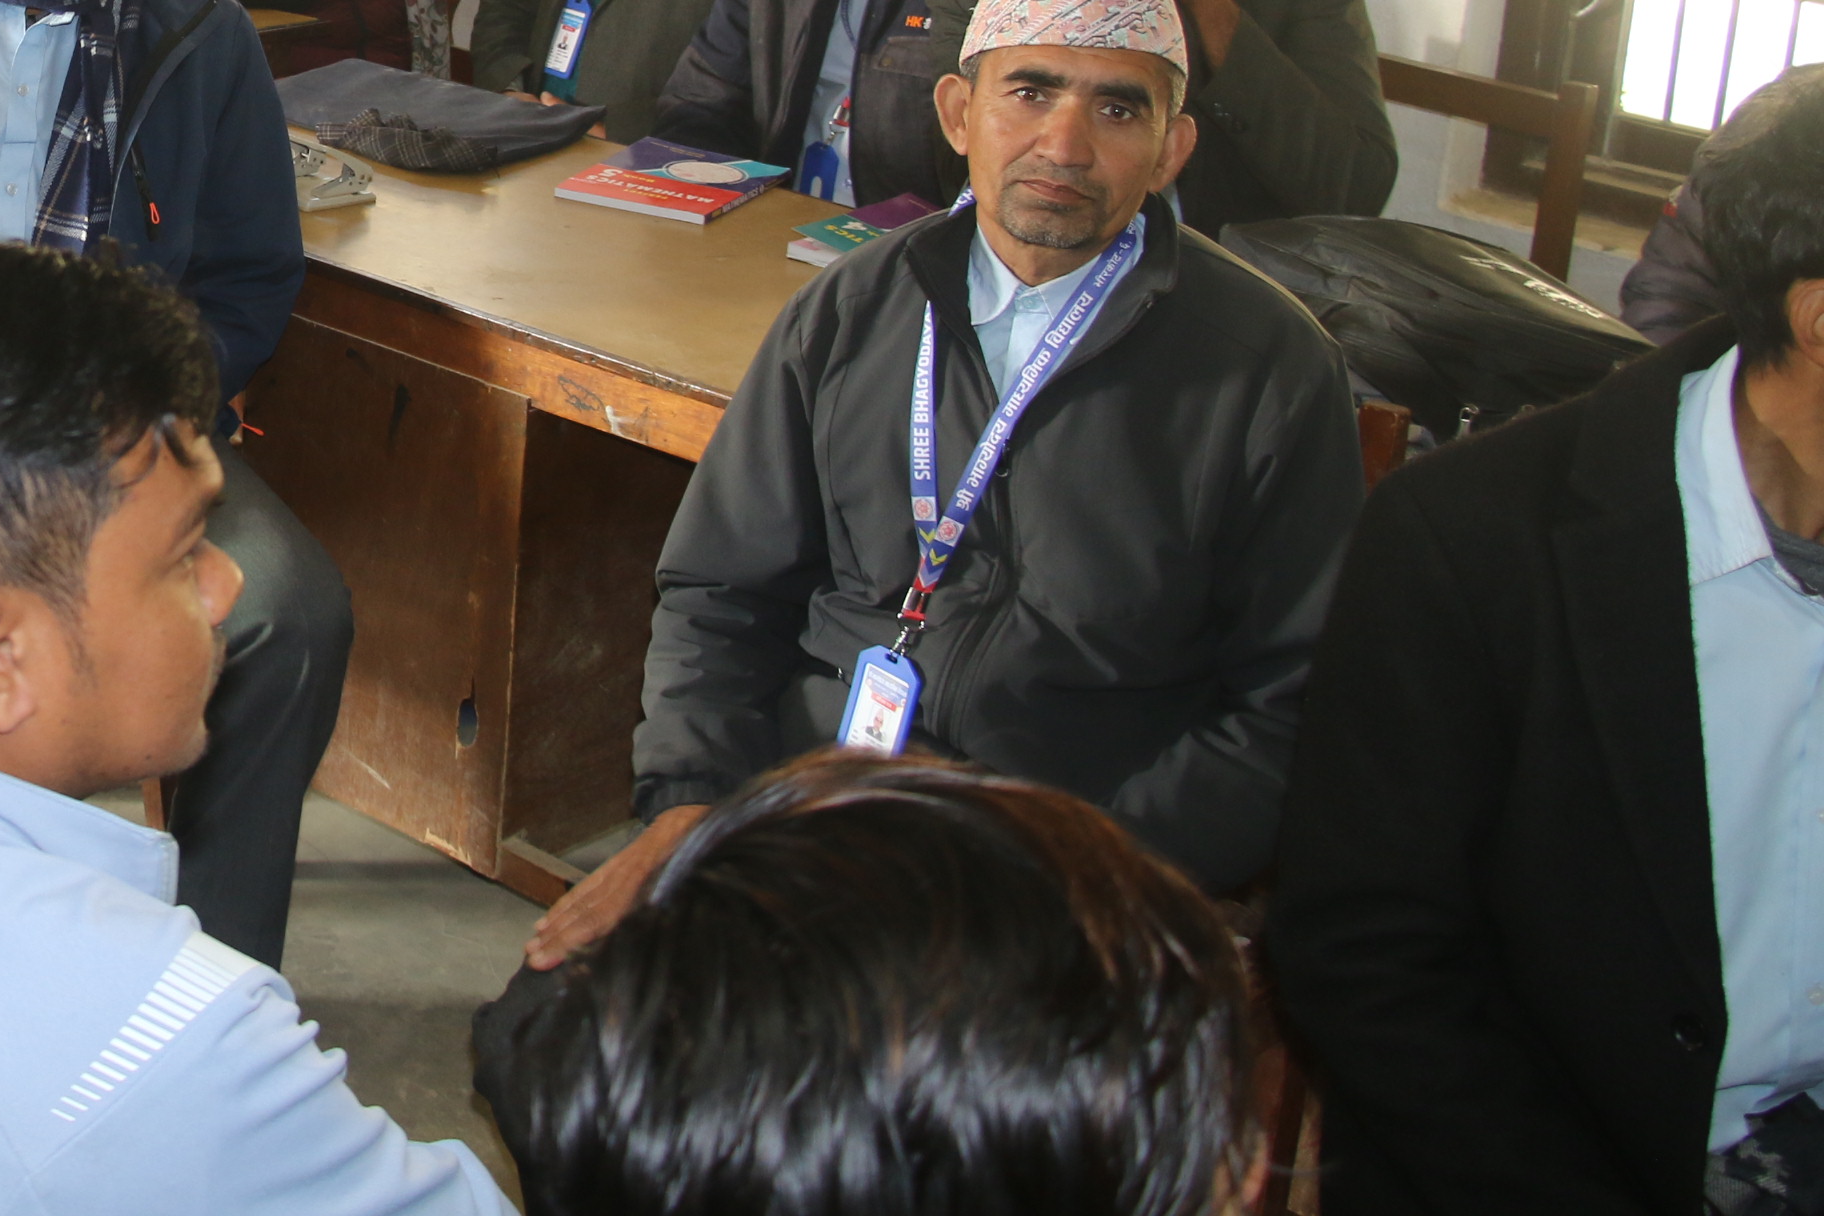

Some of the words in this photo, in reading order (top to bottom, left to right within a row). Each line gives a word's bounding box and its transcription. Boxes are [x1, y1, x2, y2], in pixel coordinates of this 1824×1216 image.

[585, 174, 715, 204] MATHEMATICS
[602, 168, 624, 178] 5
[956, 483, 976, 512] श्री
[967, 417, 1008, 488] भाग्योदय
[1003, 342, 1053, 418] माध्यमिक
[1044, 290, 1094, 349] विद्यालय
[915, 427, 932, 481] SHREE
